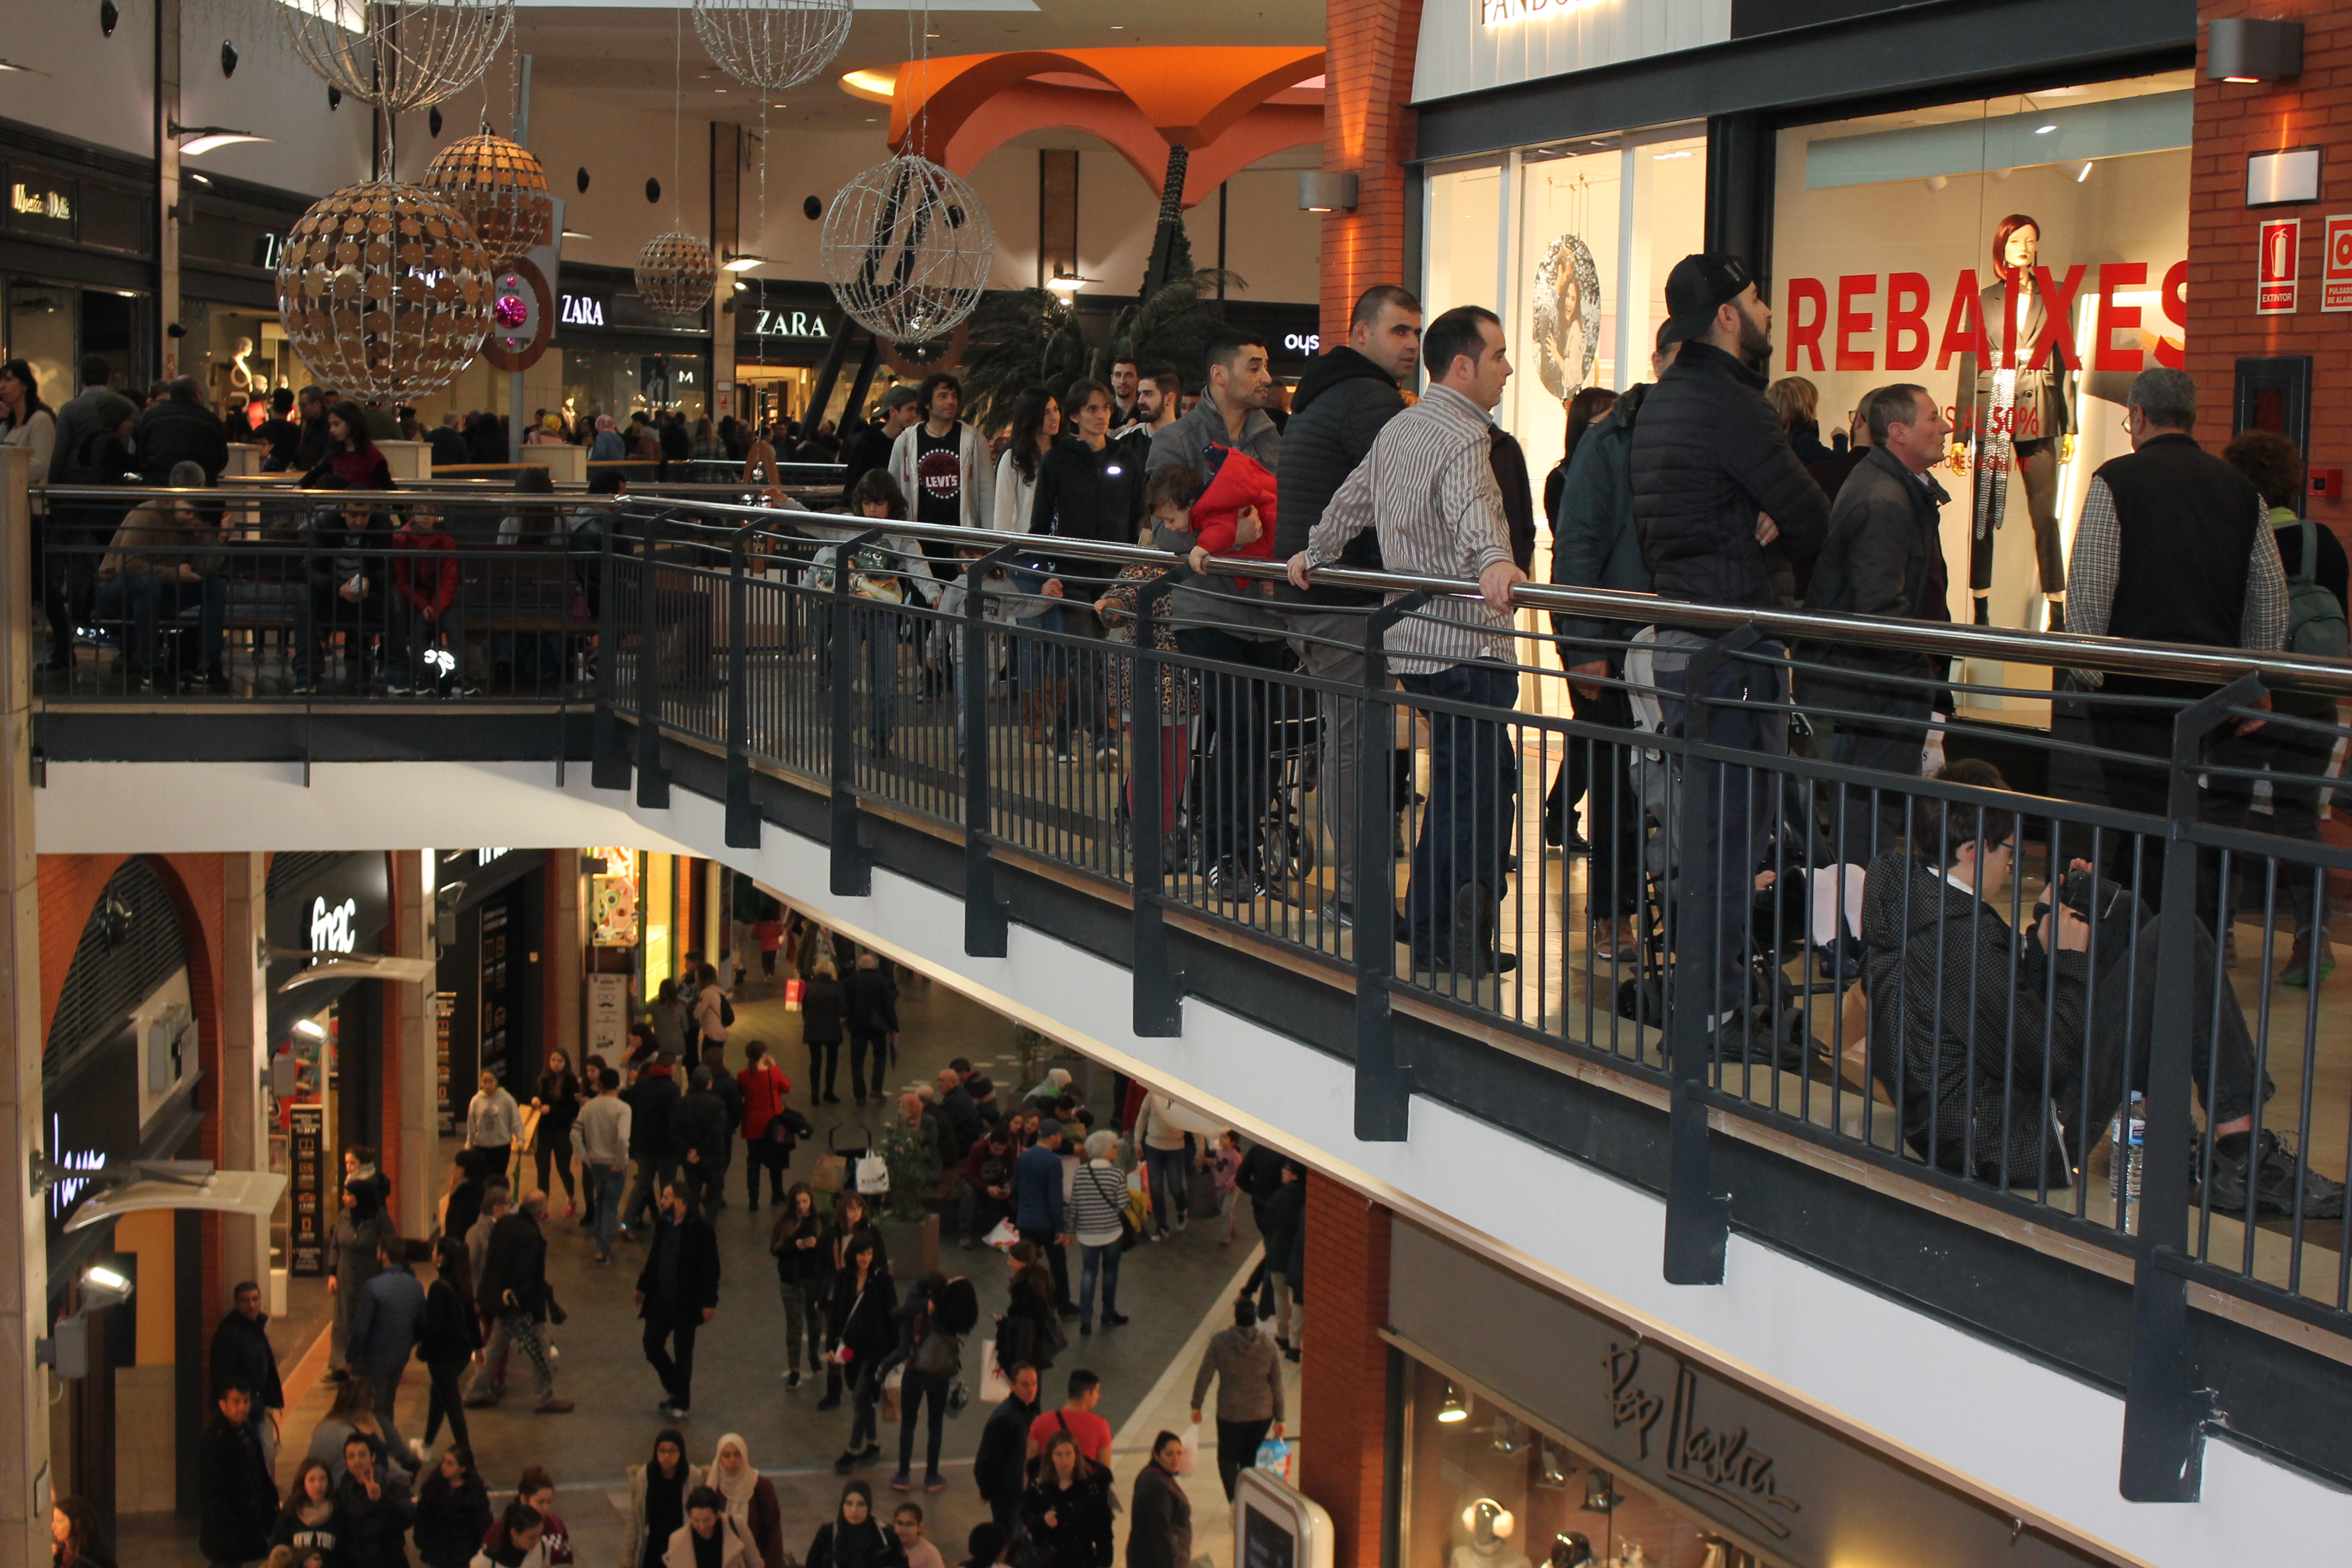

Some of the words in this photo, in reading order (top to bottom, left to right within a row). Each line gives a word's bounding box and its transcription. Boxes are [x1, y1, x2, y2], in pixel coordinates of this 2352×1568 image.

[562, 295, 604, 326] ZARA
[2262, 293, 2292, 302] EXTINTOR
[755, 309, 828, 336] ZARA
[1785, 260, 2187, 372] REBAIXES
[1961, 406, 1987, 434] AL
[1991, 406, 2040, 435] 50%
[925, 474, 958, 487] LEVI'S
[311, 896, 356, 954] fnac
